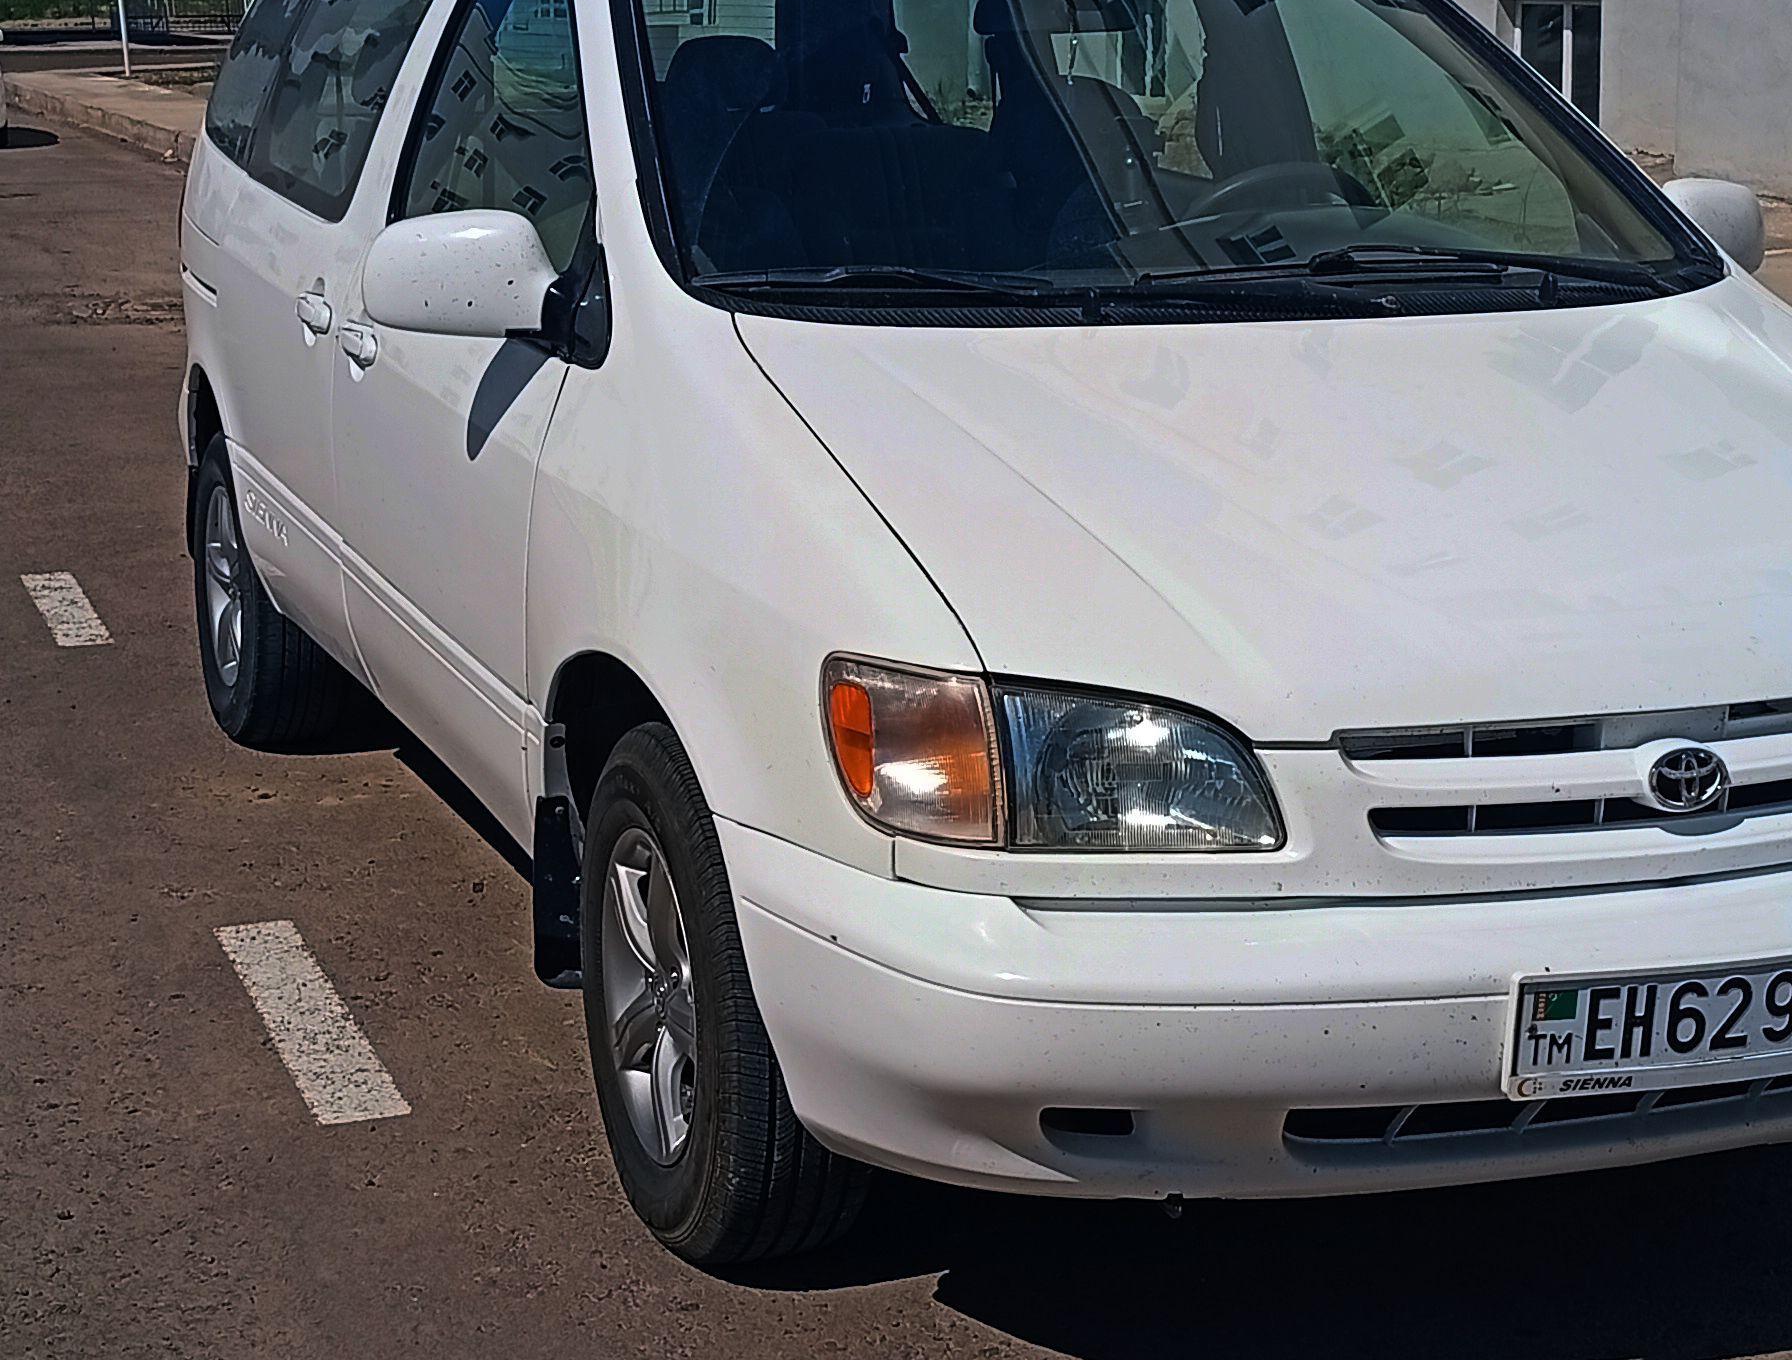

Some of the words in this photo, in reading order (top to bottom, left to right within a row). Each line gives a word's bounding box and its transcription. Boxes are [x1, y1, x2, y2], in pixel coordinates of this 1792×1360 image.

[1583, 970, 1792, 1061] EH629
[1528, 1032, 1573, 1066] TM
[1559, 1076, 1633, 1092] SIENNA
